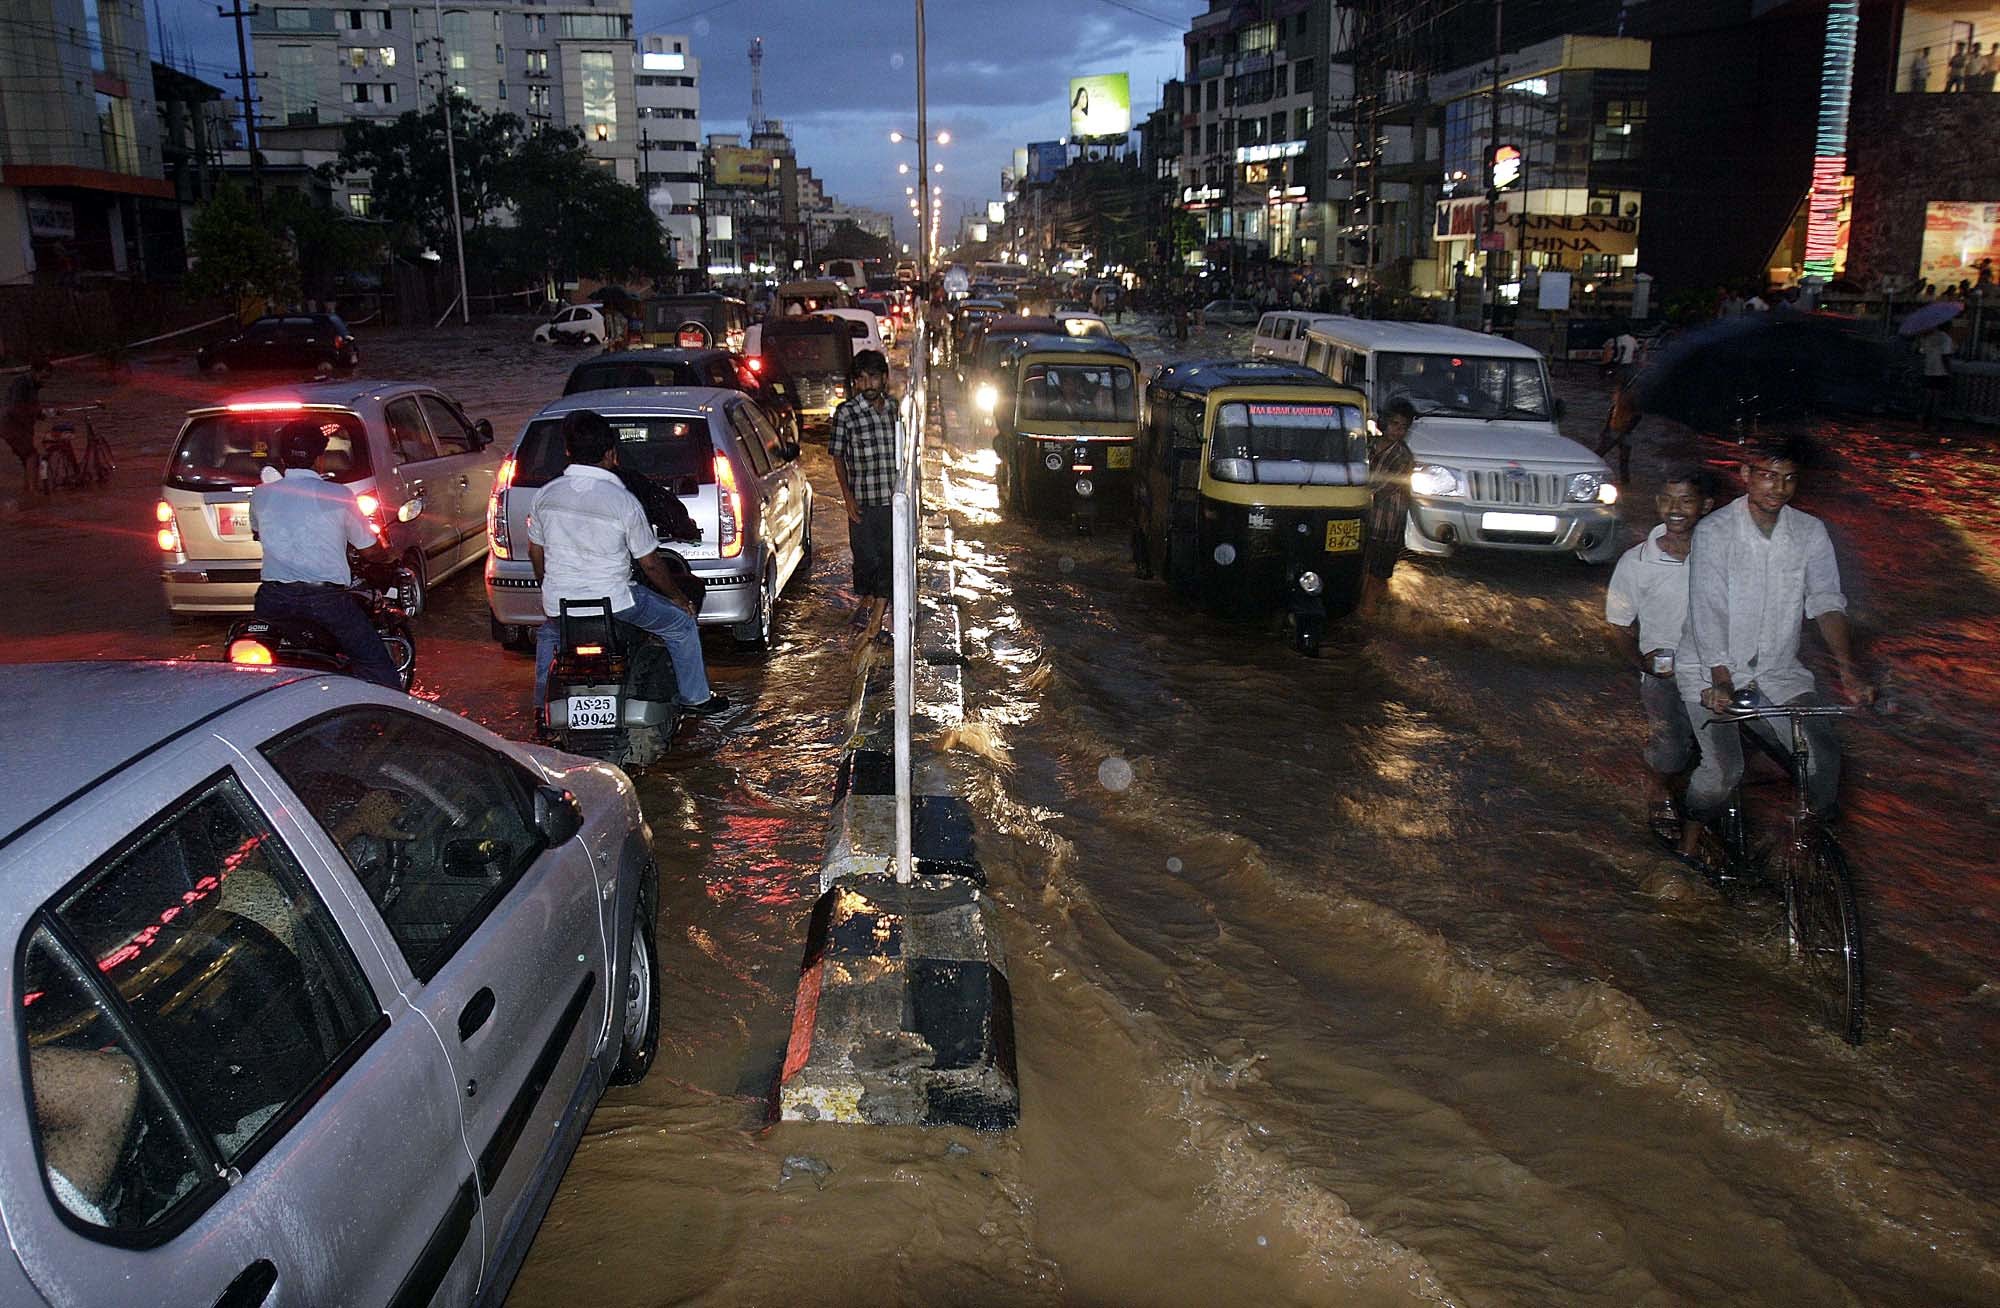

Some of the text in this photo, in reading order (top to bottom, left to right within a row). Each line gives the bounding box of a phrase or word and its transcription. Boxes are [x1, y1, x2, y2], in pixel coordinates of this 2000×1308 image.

[1495, 213, 1637, 234] MAINLAND
[1520, 235, 1600, 252] CHINA
[571, 713, 615, 727] A9942
